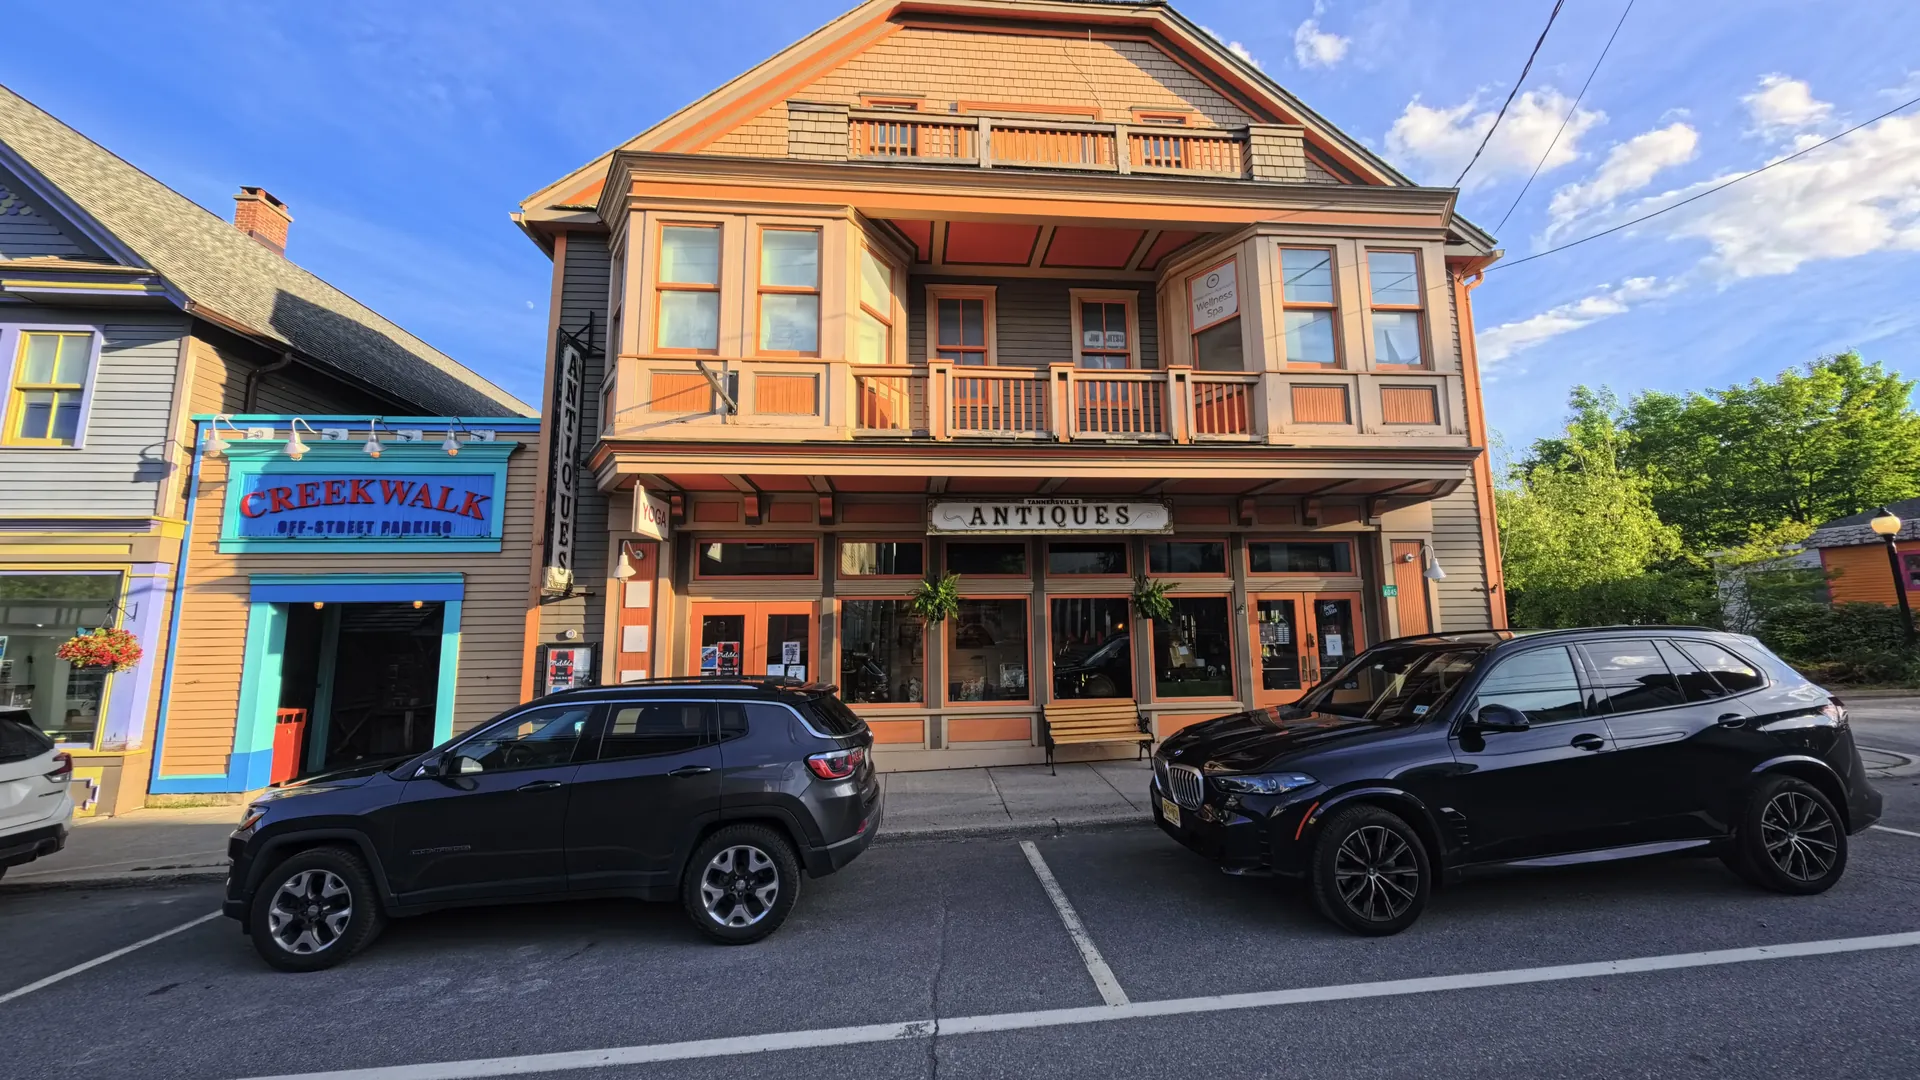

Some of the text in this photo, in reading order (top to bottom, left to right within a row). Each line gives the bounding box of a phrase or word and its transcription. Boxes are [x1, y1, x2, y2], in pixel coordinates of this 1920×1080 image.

[1196, 290, 1233, 312] Wellness
[1207, 305, 1224, 319] Spa
[557, 353, 579, 576] ANTIQUES
[240, 479, 491, 521] CREEKWALK
[277, 520, 453, 535] OFF-STREET PARKING
[643, 502, 667, 529] YOGA
[969, 504, 1131, 528] ANTIQUES
